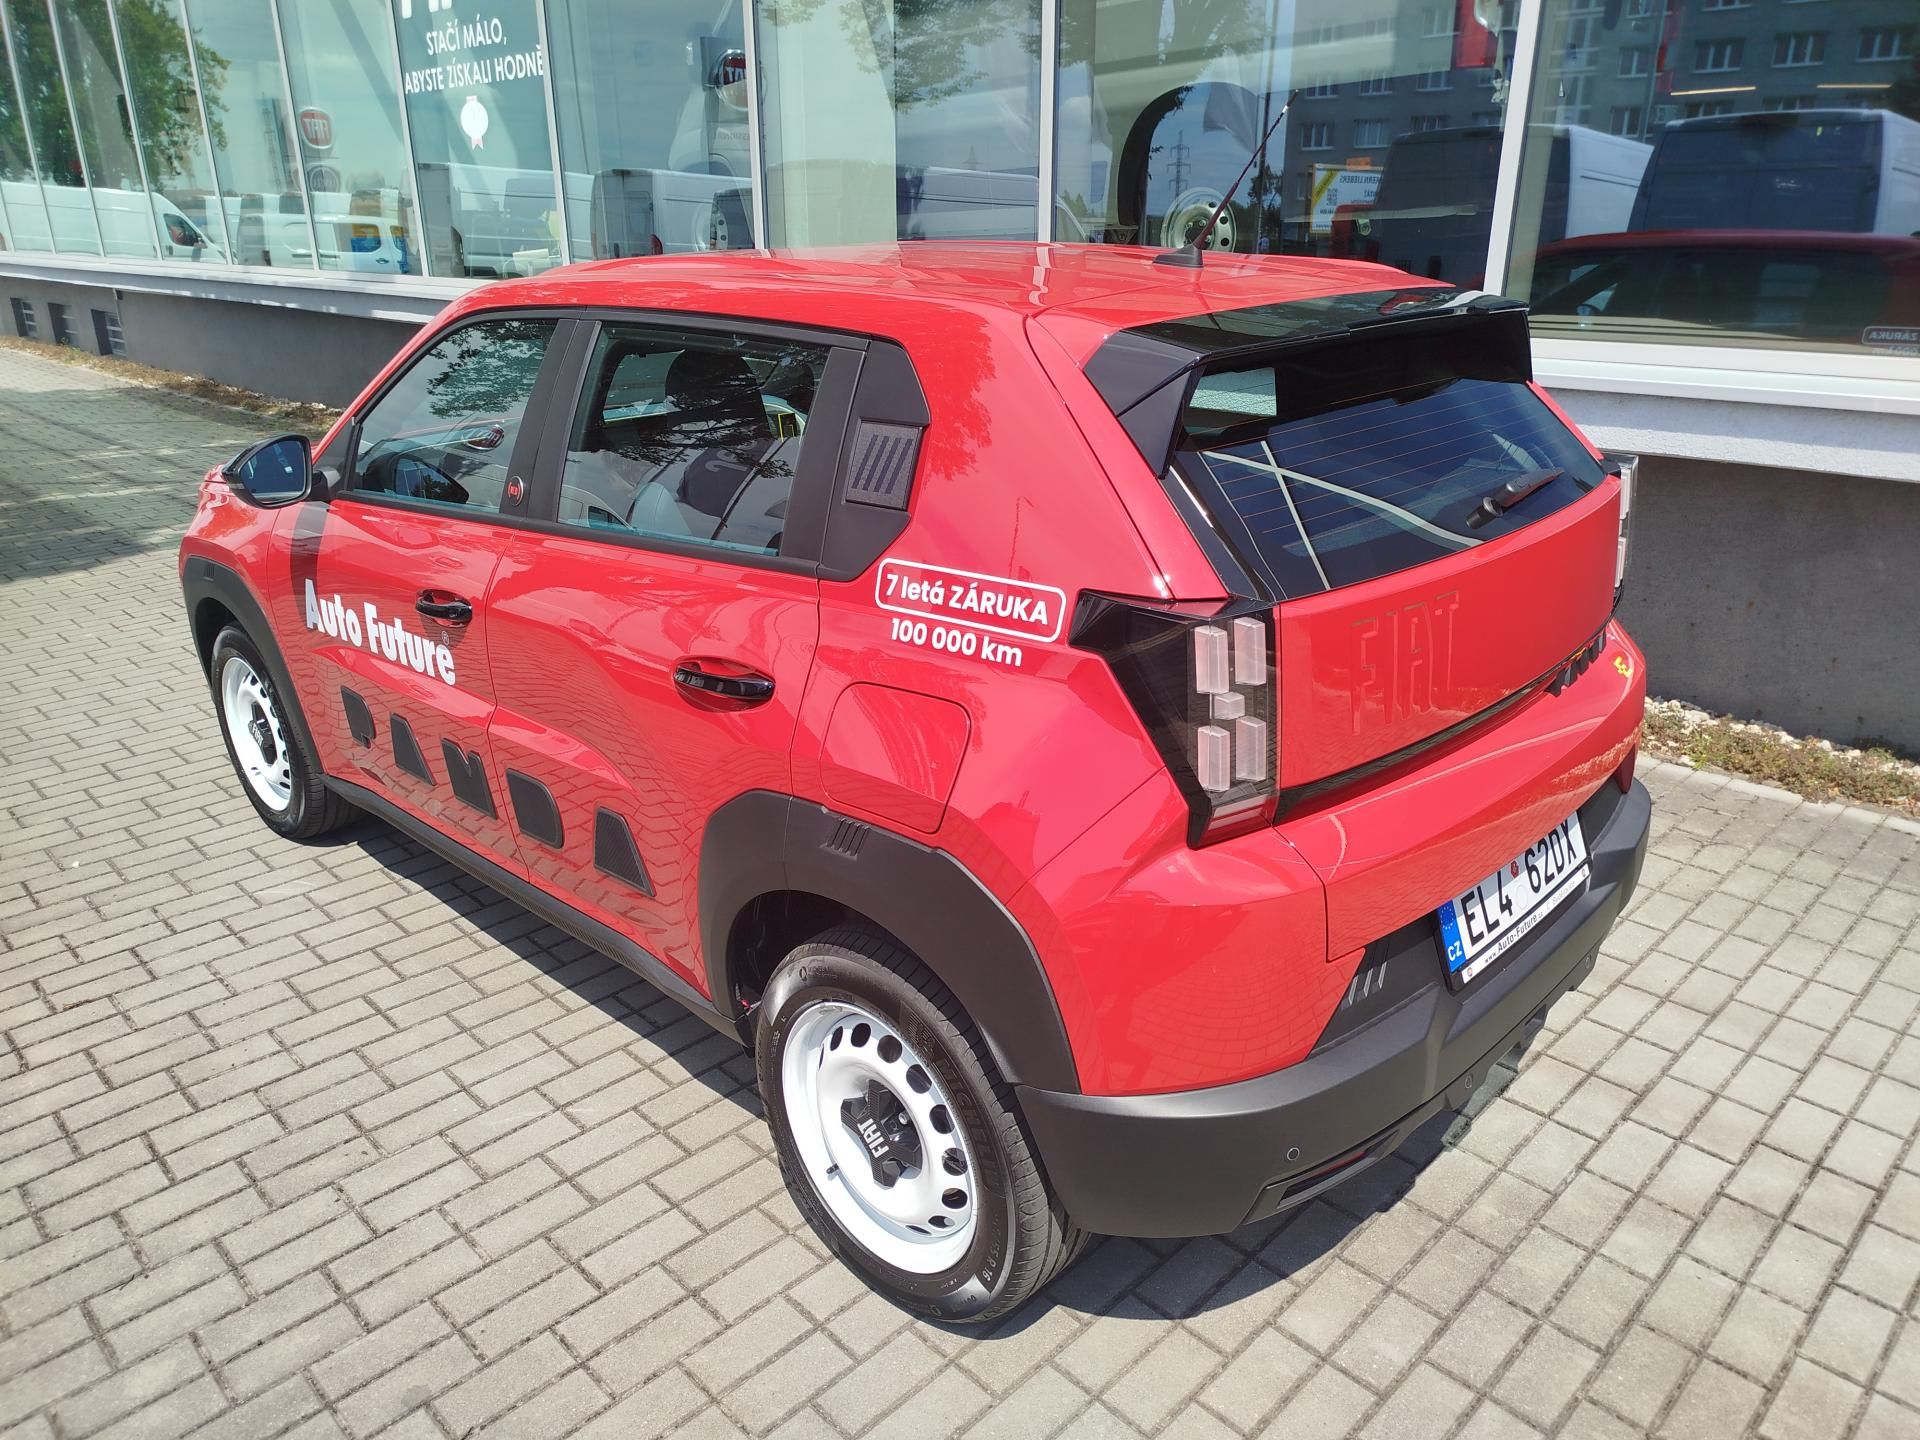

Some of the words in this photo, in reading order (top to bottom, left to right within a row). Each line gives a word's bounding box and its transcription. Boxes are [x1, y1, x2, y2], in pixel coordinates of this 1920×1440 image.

[426, 18, 461, 56] STAČÍ
[463, 13, 507, 49] MÁLO,
[405, 66, 445, 95] ABYSTE
[446, 57, 493, 89] ZÍSKALI
[494, 44, 544, 82] HODNĚ
[885, 573, 899, 596] 7
[900, 576, 945, 606] letá
[948, 582, 1048, 625] ZÁRUKA
[305, 579, 362, 647] Auto
[363, 602, 456, 686] Future
[891, 617, 927, 646] 100
[931, 626, 976, 656] 000
[981, 636, 1022, 667] km
[1350, 590, 1459, 735] FIAT
[1460, 870, 1513, 948] EL4
[1524, 819, 1577, 894] 62DX
[1447, 939, 1463, 962] CZ
[857, 1117, 889, 1159] FIAT
